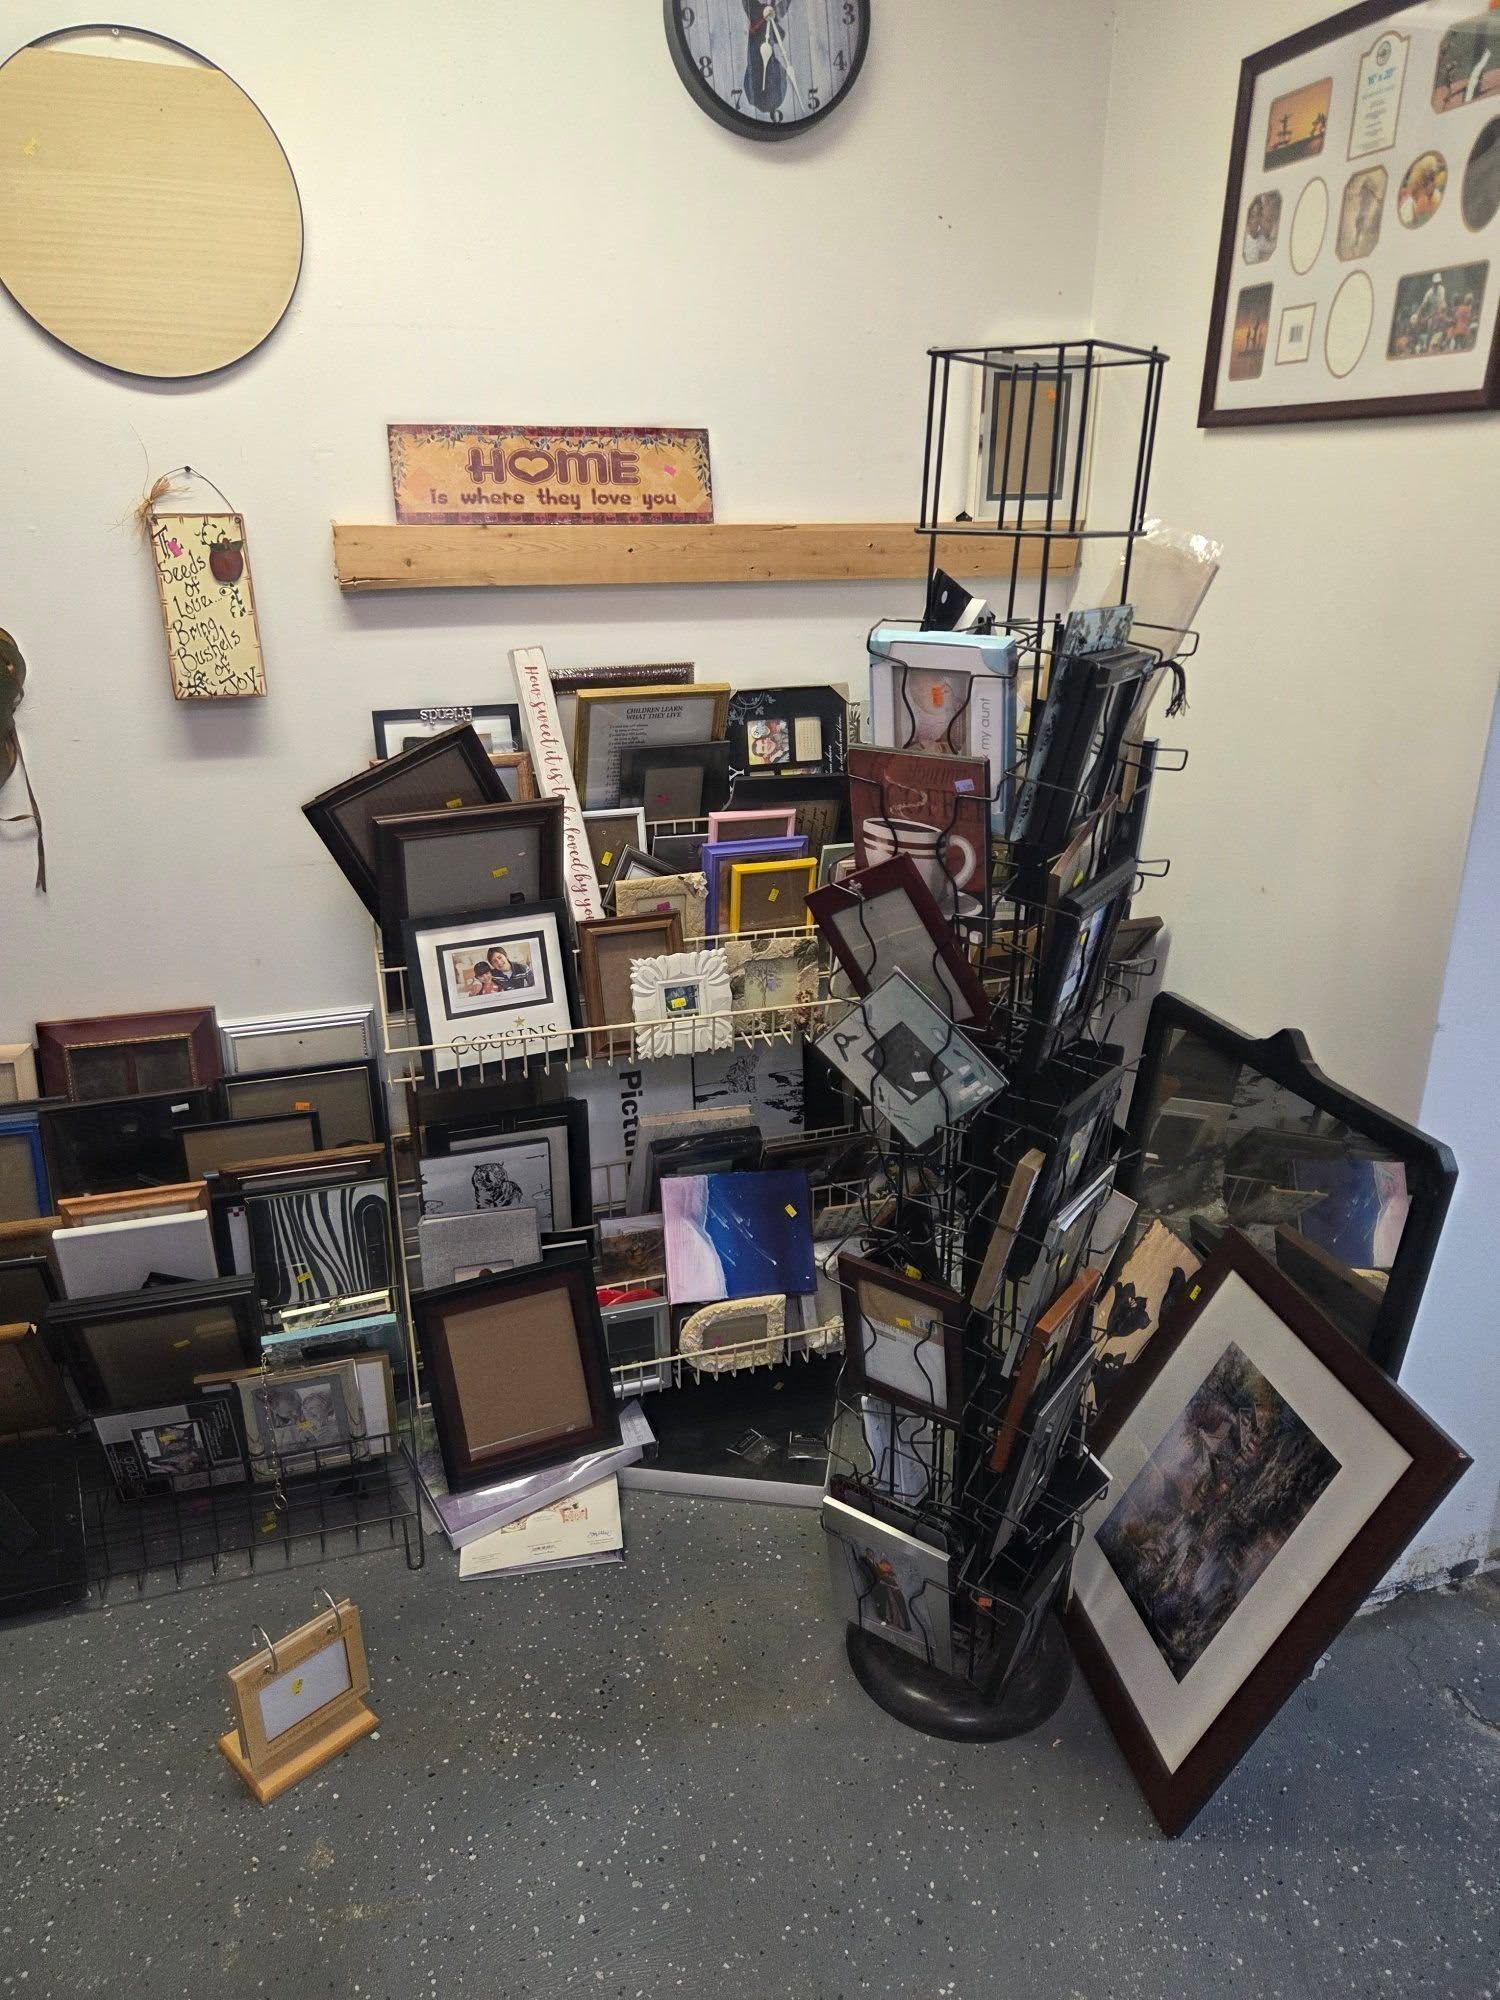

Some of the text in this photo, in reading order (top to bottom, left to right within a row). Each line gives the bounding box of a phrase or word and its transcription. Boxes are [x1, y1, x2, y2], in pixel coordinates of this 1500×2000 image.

[682, 7, 695, 29] 9
[843, 2, 855, 25] 3
[699, 56, 713, 78] 8
[833, 50, 847, 72] 4
[731, 89, 743, 110] 7
[808, 88, 821, 110] 5
[769, 109, 784, 125] 6
[465, 446, 641, 486] HOME
[430, 488, 677, 510] is where they love you
[151, 524, 184, 559] Th
[158, 550, 206, 584] Seeds
[185, 575, 200, 597] of
[173, 617, 221, 647] Bring
[177, 625, 241, 673] Bushels
[215, 656, 231, 676] of
[524, 666, 542, 698] How
[419, 707, 474, 725] Friends
[528, 701, 560, 750] sweet
[981, 698, 994, 751] my aunt
[544, 750, 565, 767] it
[546, 768, 568, 784] is
[564, 827, 590, 872] loved
[570, 873, 593, 897] by
[450, 1023, 559, 1055] COUSINS
